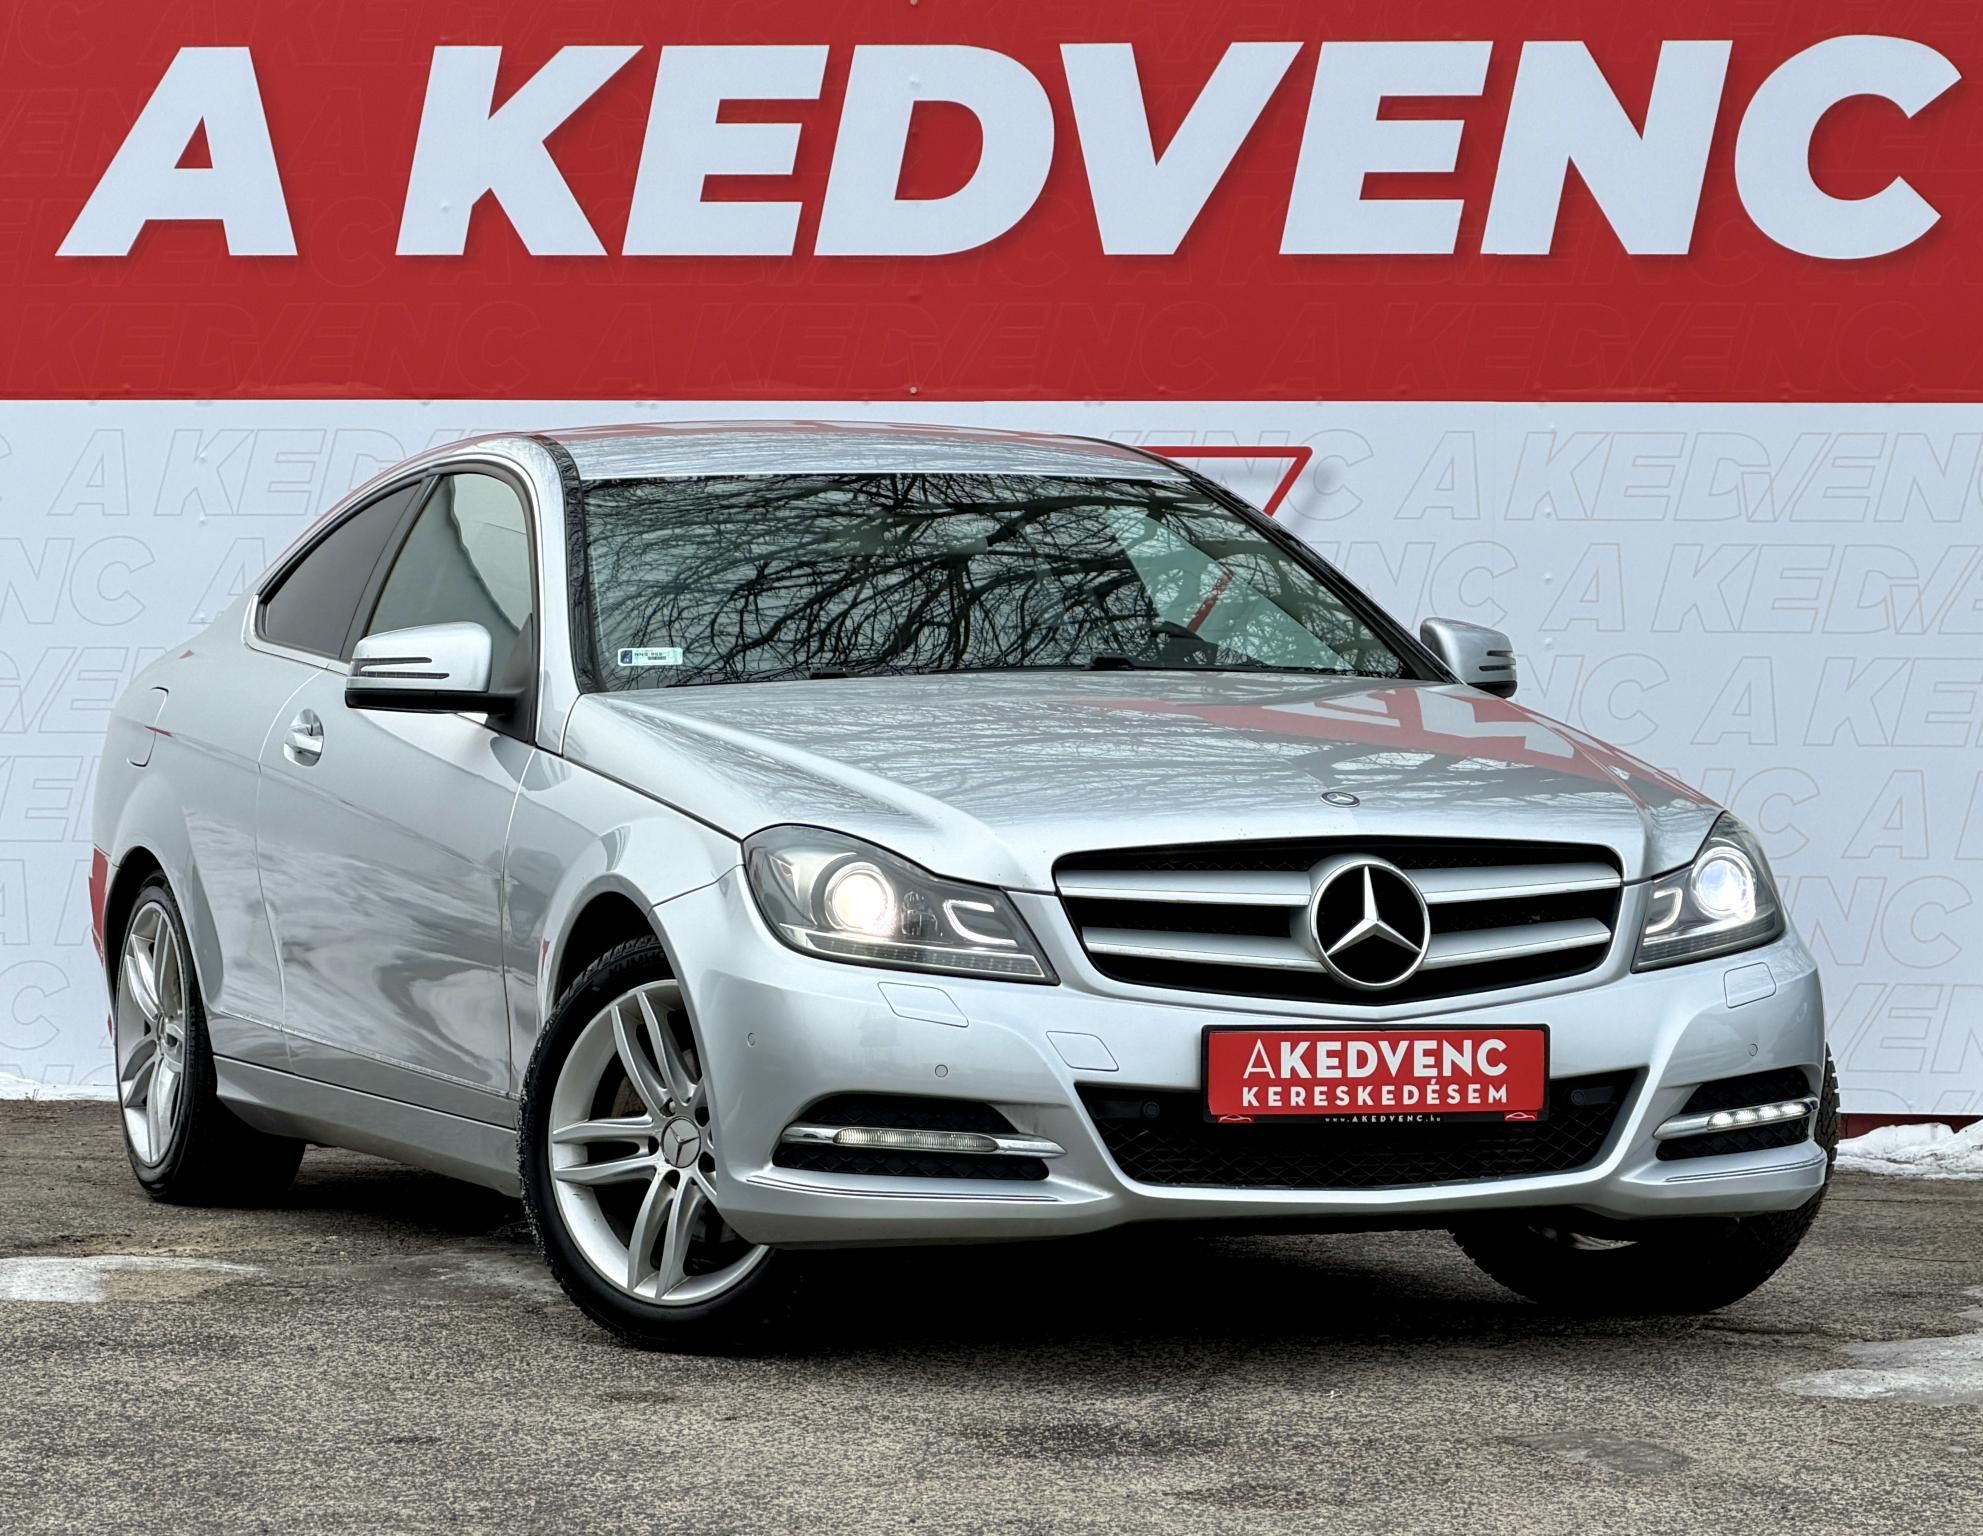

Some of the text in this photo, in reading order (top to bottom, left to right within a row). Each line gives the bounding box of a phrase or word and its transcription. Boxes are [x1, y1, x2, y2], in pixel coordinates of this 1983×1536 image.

[57, 46, 298, 258] A
[396, 34, 1962, 262] KEDVENC
[1504, 430, 1983, 524] KEDVEN
[1242, 1079, 1508, 1107] KERESKEDÉSEM
